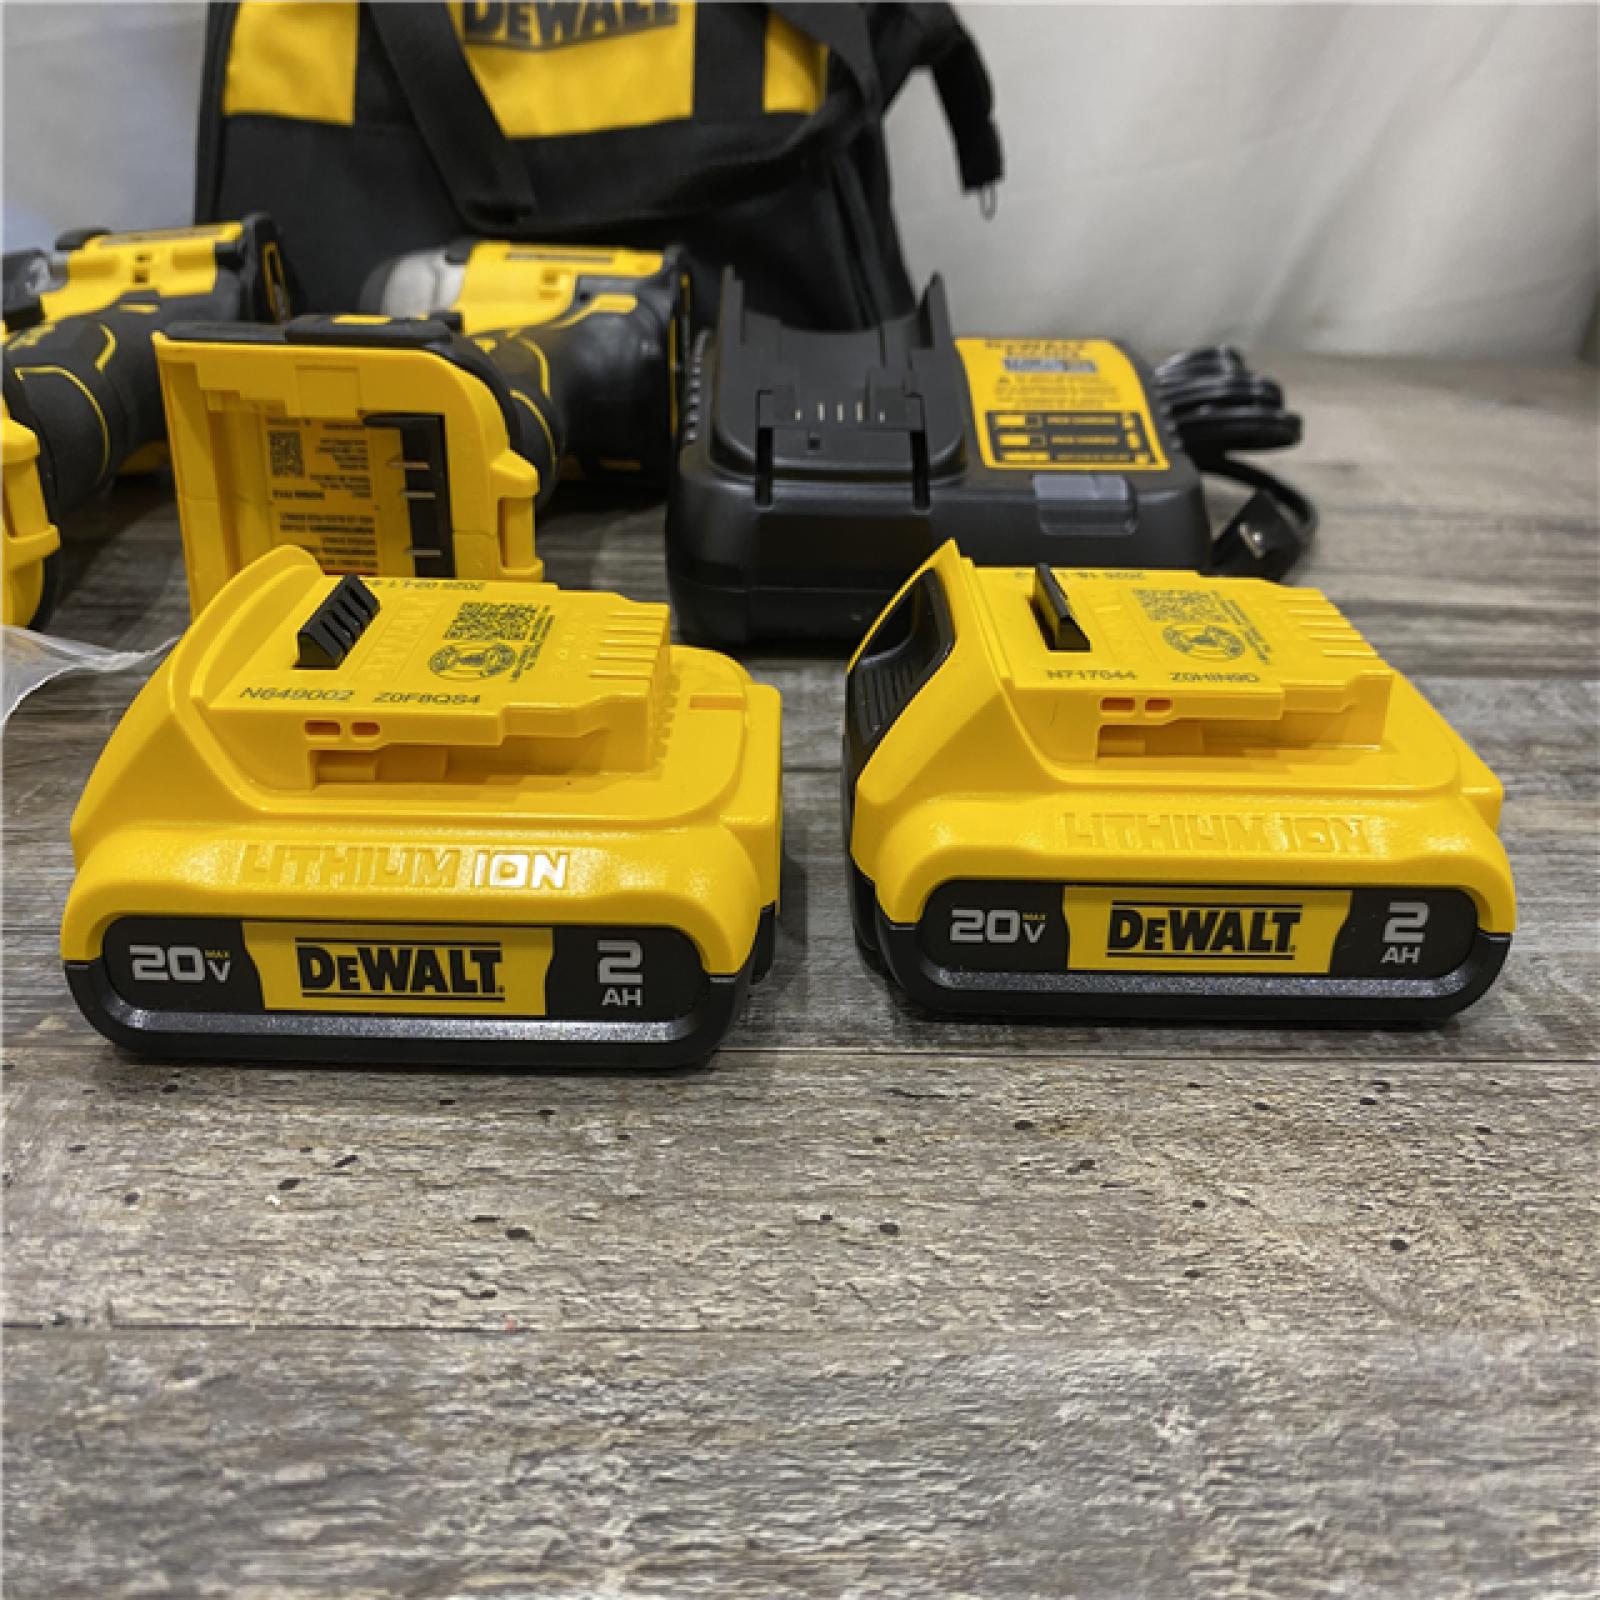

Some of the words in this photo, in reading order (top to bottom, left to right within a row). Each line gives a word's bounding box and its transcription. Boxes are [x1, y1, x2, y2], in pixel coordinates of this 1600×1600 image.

[1063, 811, 1271, 851] LITHIUM
[1281, 815, 1370, 855] ION
[238, 843, 460, 888] LITHIUM
[472, 852, 569, 890] ION
[1106, 908, 1303, 954] DEWALT
[1382, 902, 1429, 943] 2
[297, 945, 504, 995] DEWALT
[597, 939, 644, 986] 2
[1381, 946, 1421, 964] AH
[600, 987, 644, 1008] AH
